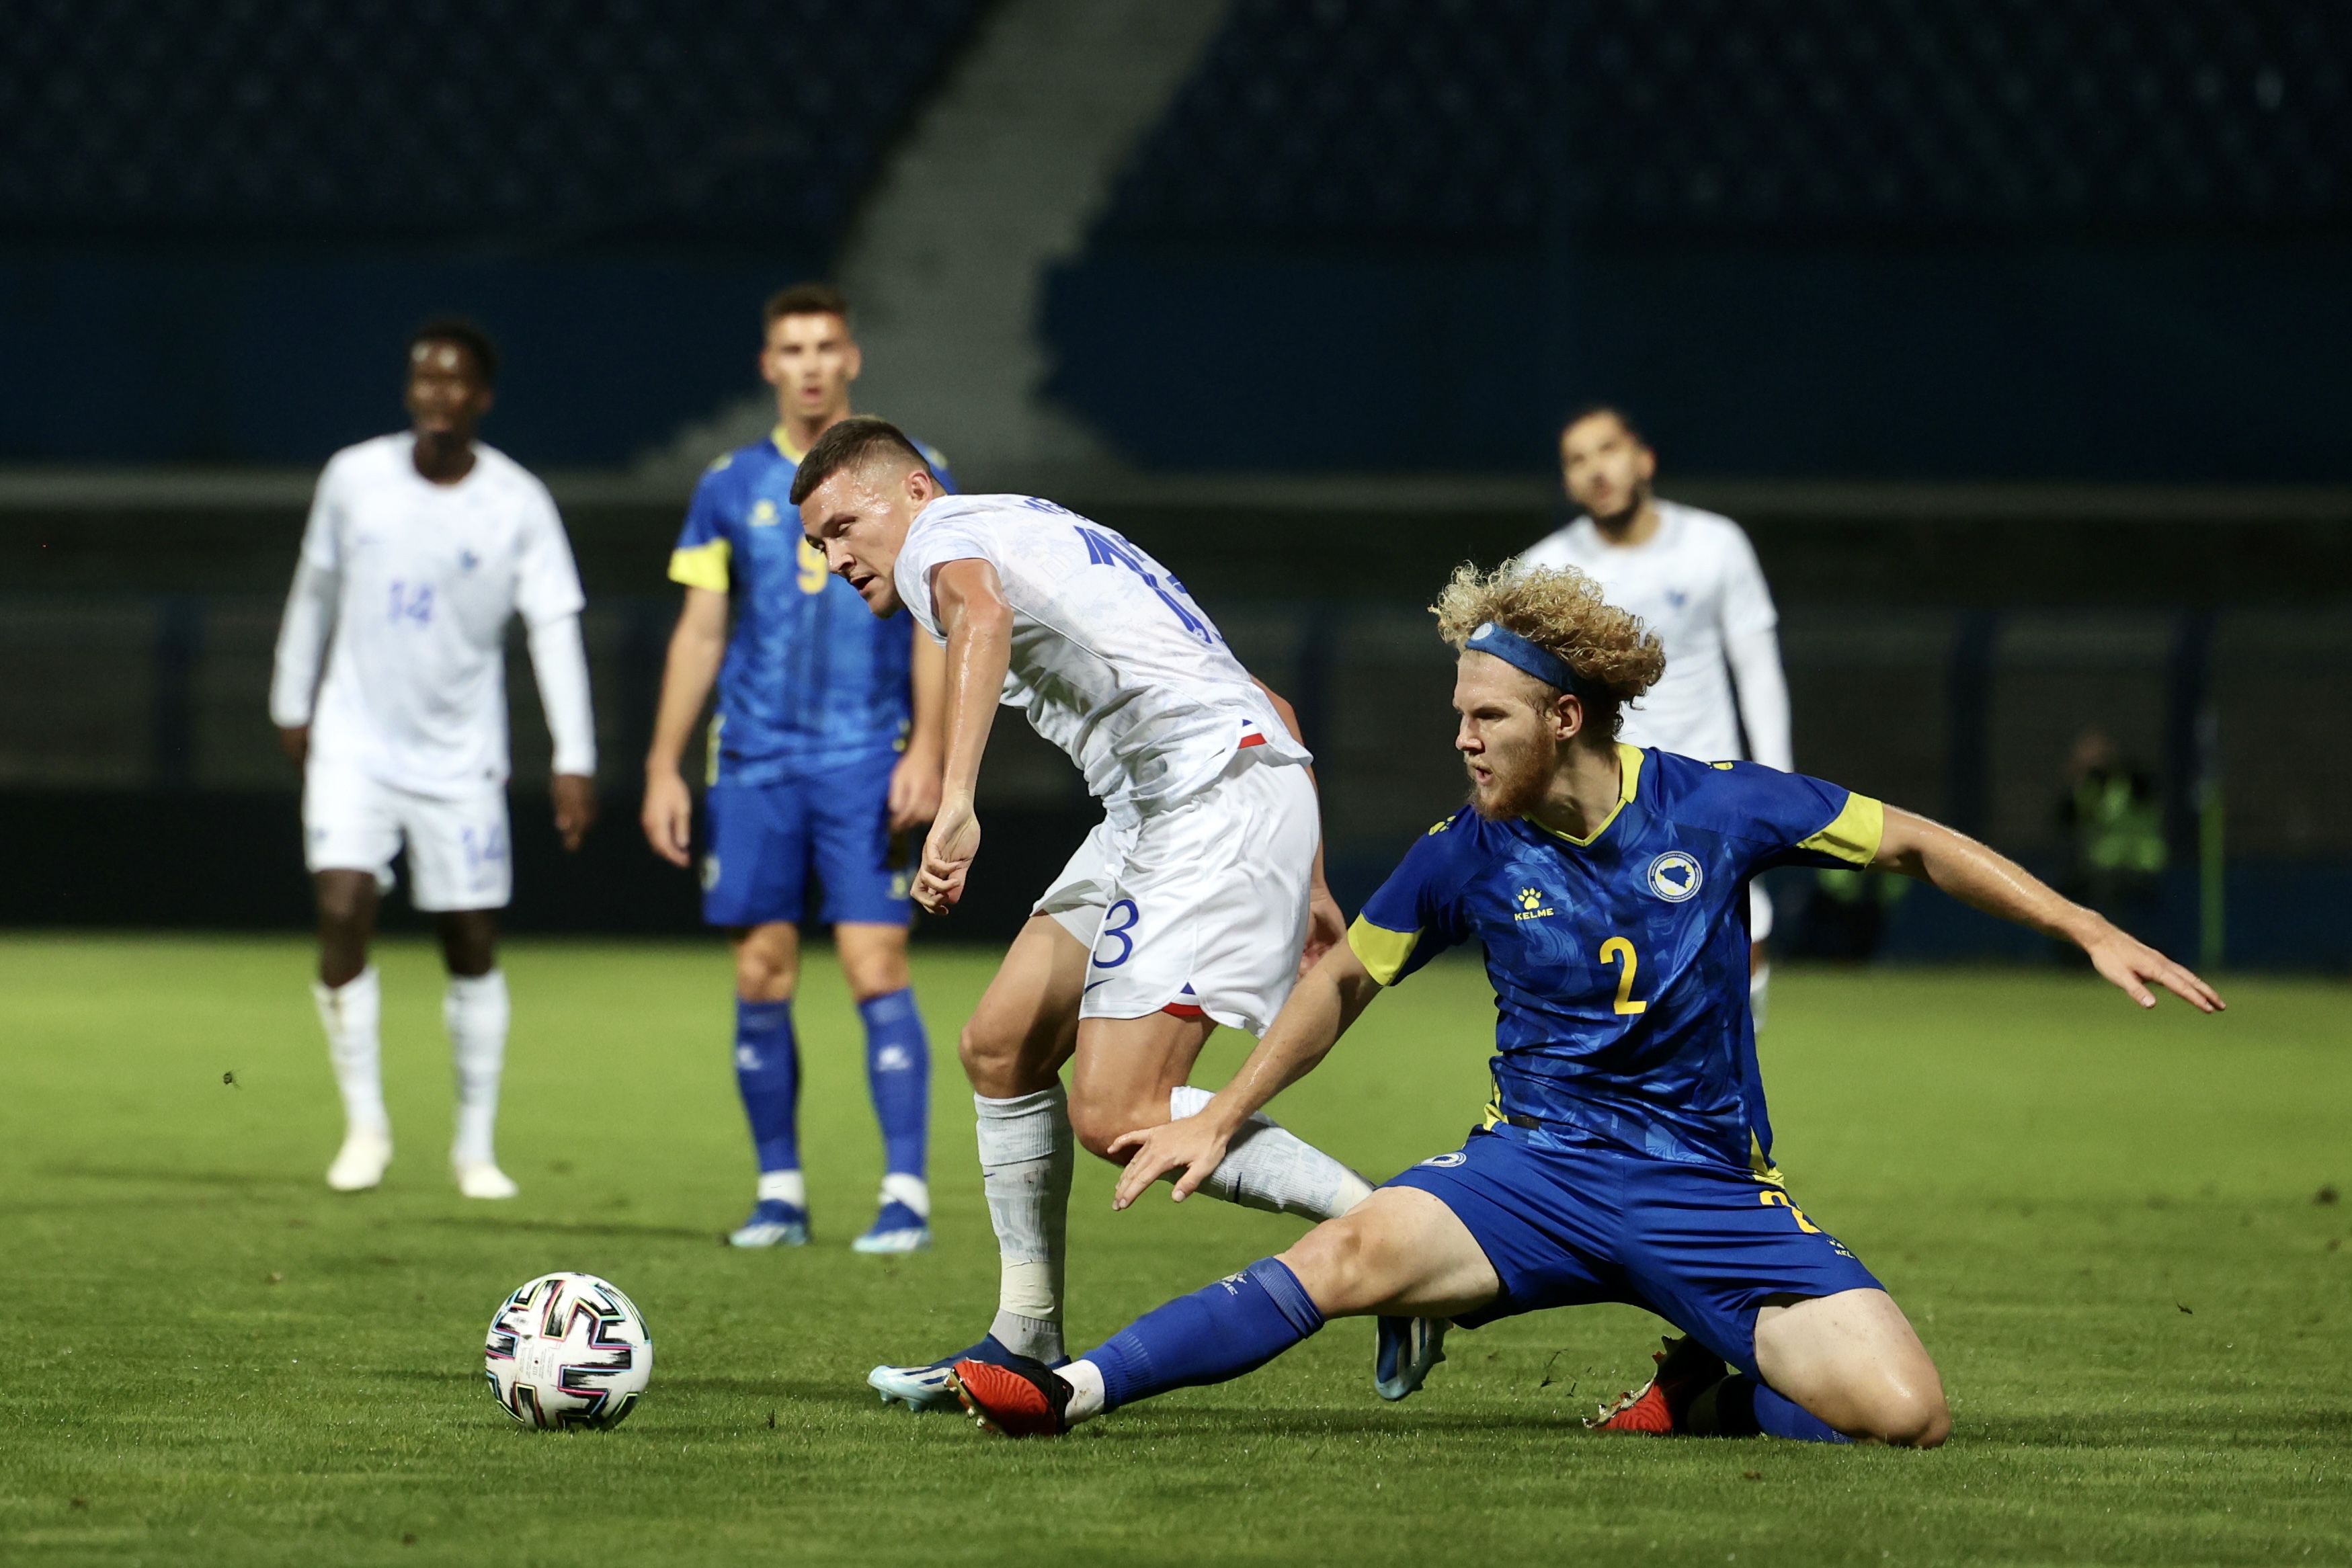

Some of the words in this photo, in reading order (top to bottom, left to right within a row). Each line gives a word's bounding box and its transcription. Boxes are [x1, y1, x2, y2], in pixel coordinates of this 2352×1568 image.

[797, 534, 828, 594] 9
[389, 581, 434, 624] 14
[1514, 907, 1554, 921] KELME
[1599, 936, 1647, 1015] 2
[1759, 1190, 1822, 1233] 2
